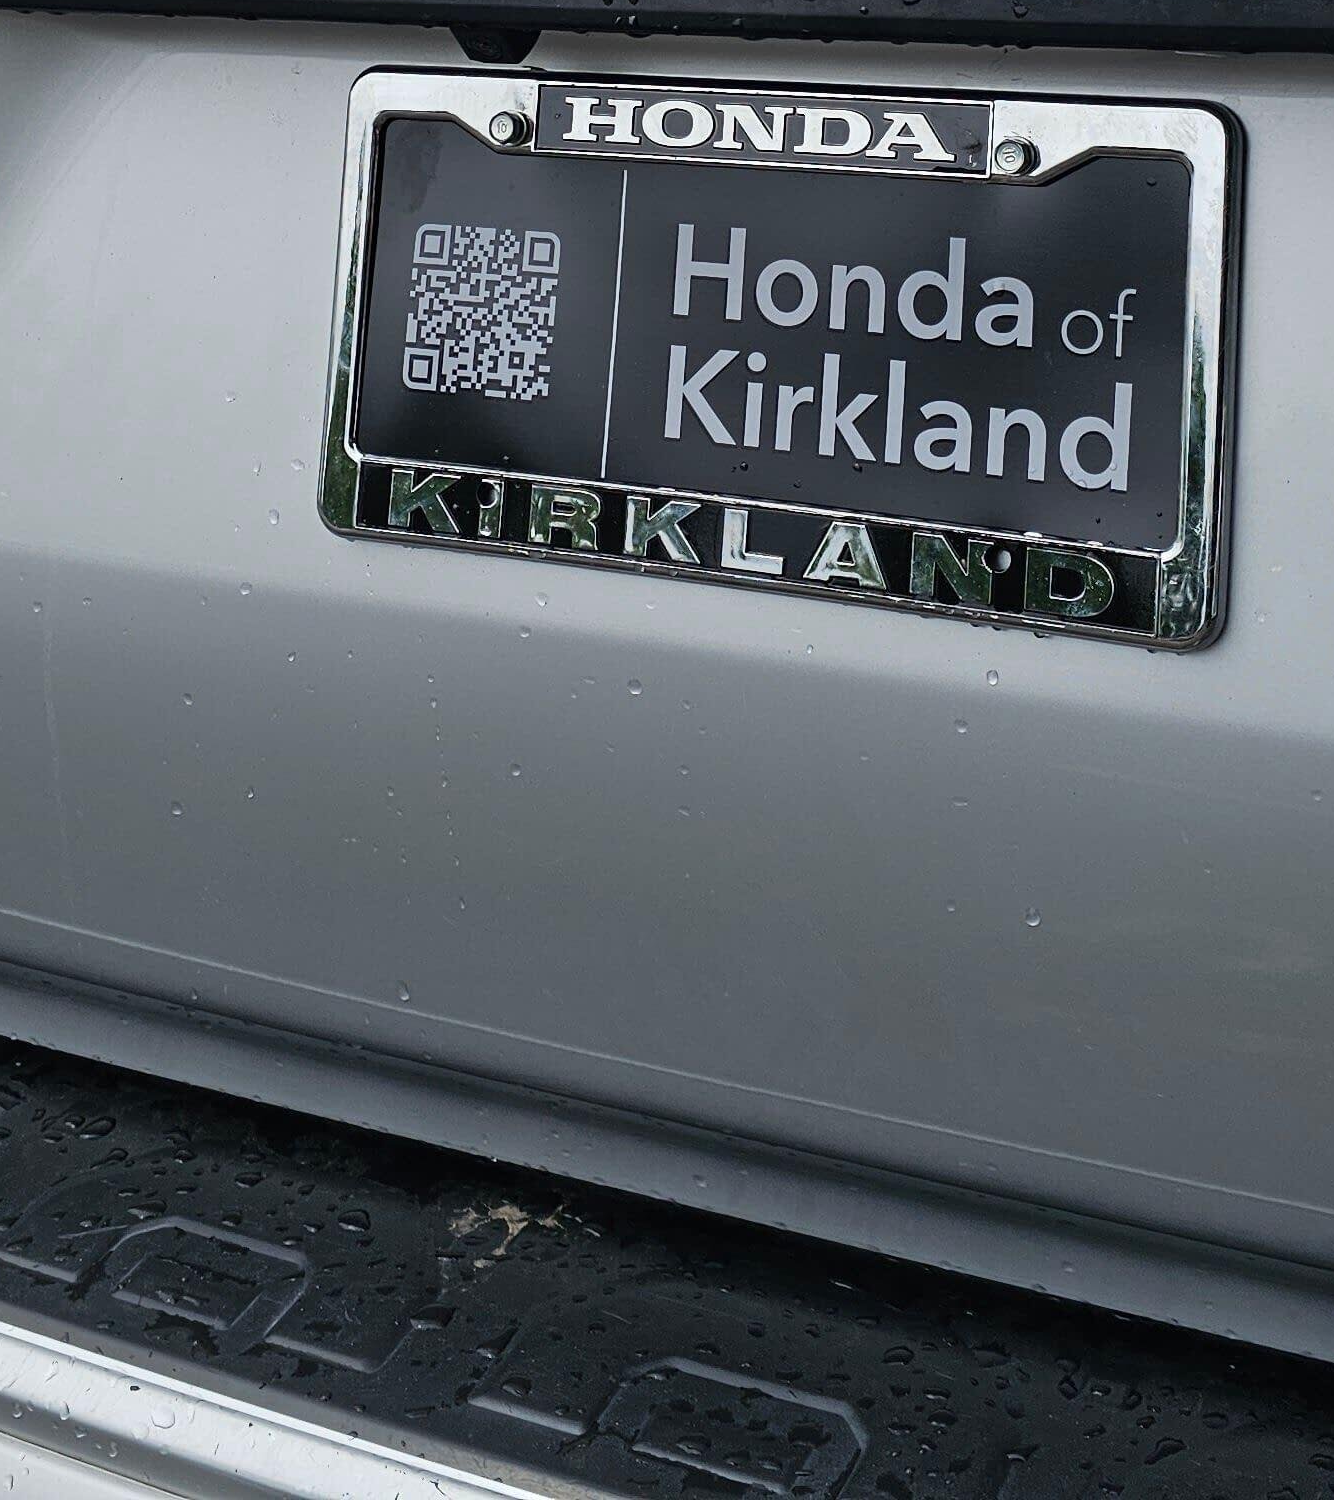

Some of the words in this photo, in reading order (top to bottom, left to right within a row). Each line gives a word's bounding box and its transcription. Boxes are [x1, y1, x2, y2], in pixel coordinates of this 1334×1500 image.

[562, 96, 957, 164] HONDA
[671, 222, 1035, 349] Honda
[1061, 288, 1138, 358] of
[664, 345, 1133, 493] Kirkland
[387, 468, 1116, 618] KIRKLAND
